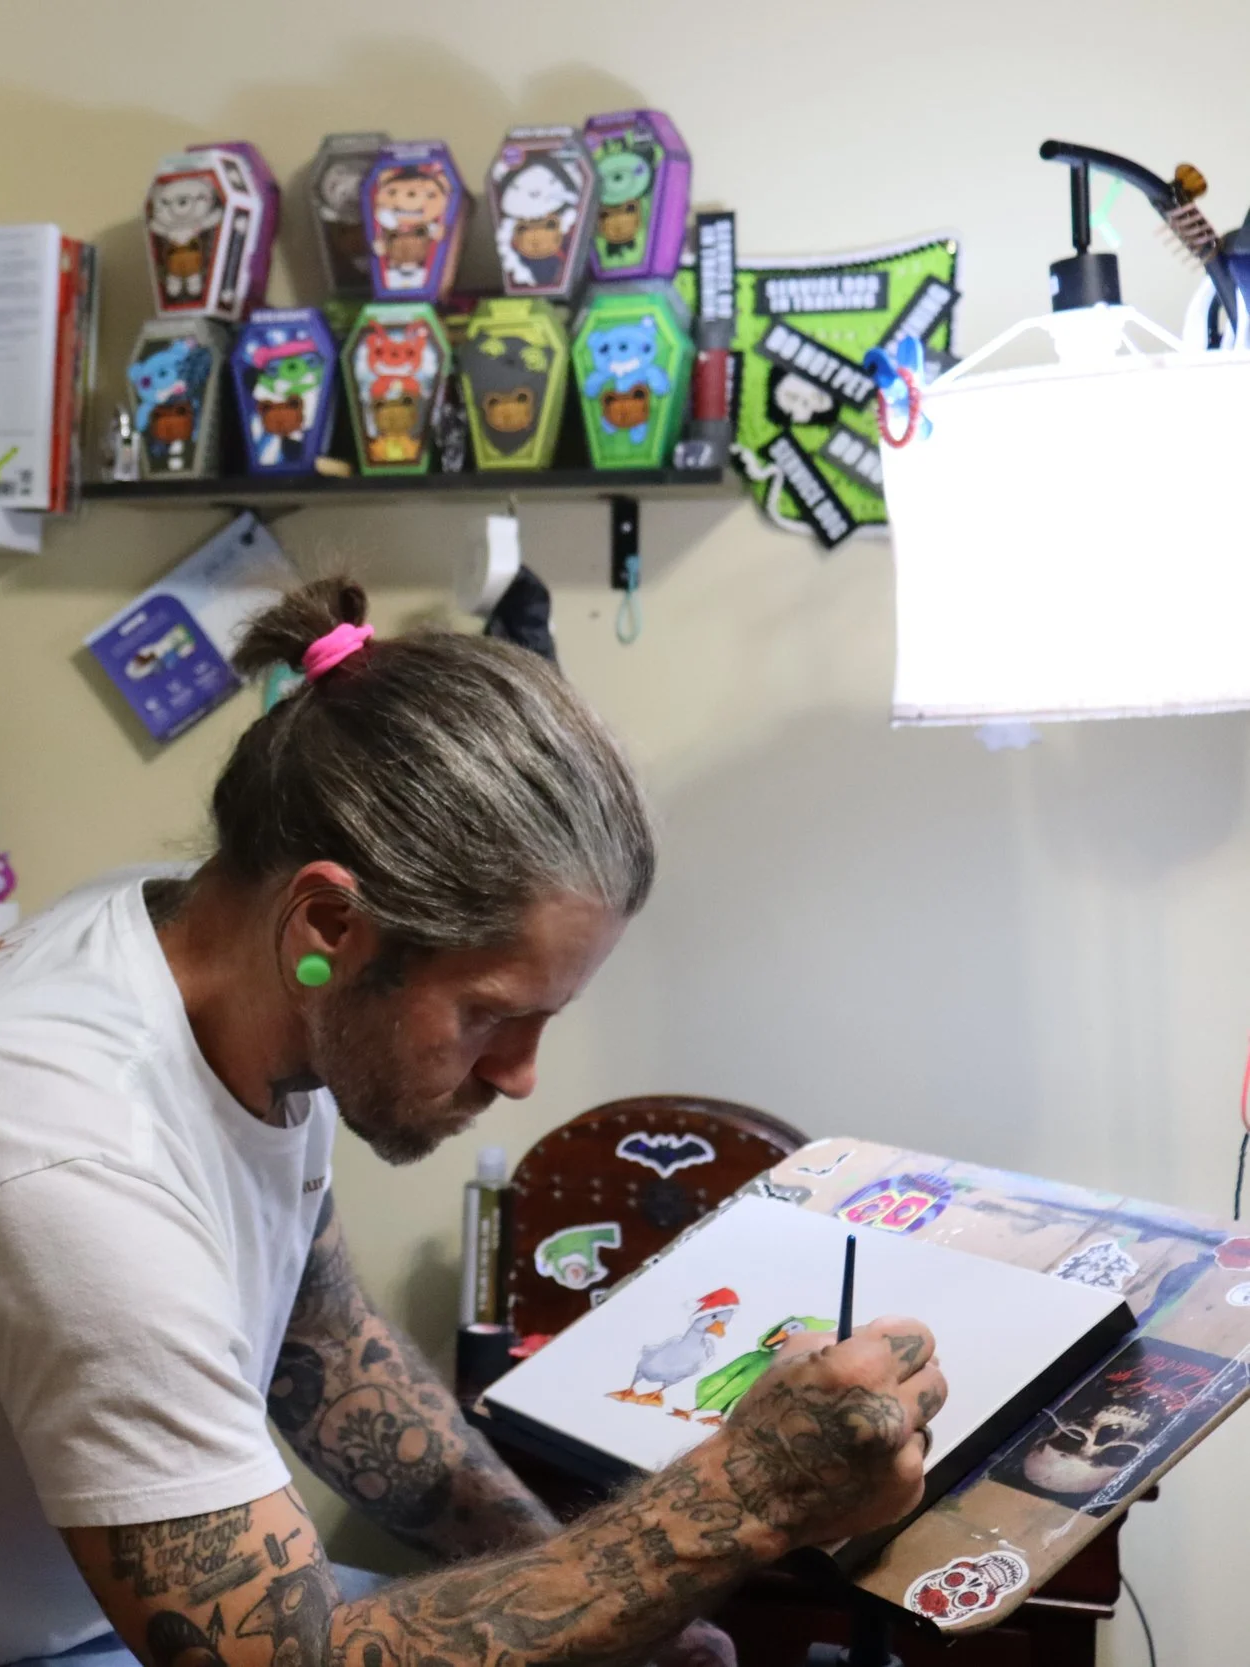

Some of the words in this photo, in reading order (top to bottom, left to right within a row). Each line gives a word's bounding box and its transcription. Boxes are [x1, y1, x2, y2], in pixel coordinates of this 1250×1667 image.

[765, 277, 839, 297] SERVICE
[765, 324, 801, 361] DO
[794, 343, 841, 383] NOT
[830, 366, 876, 403] PET
[768, 437, 826, 508] SERVICE
[813, 498, 848, 540] DOG
[855, 450, 884, 484] NO
